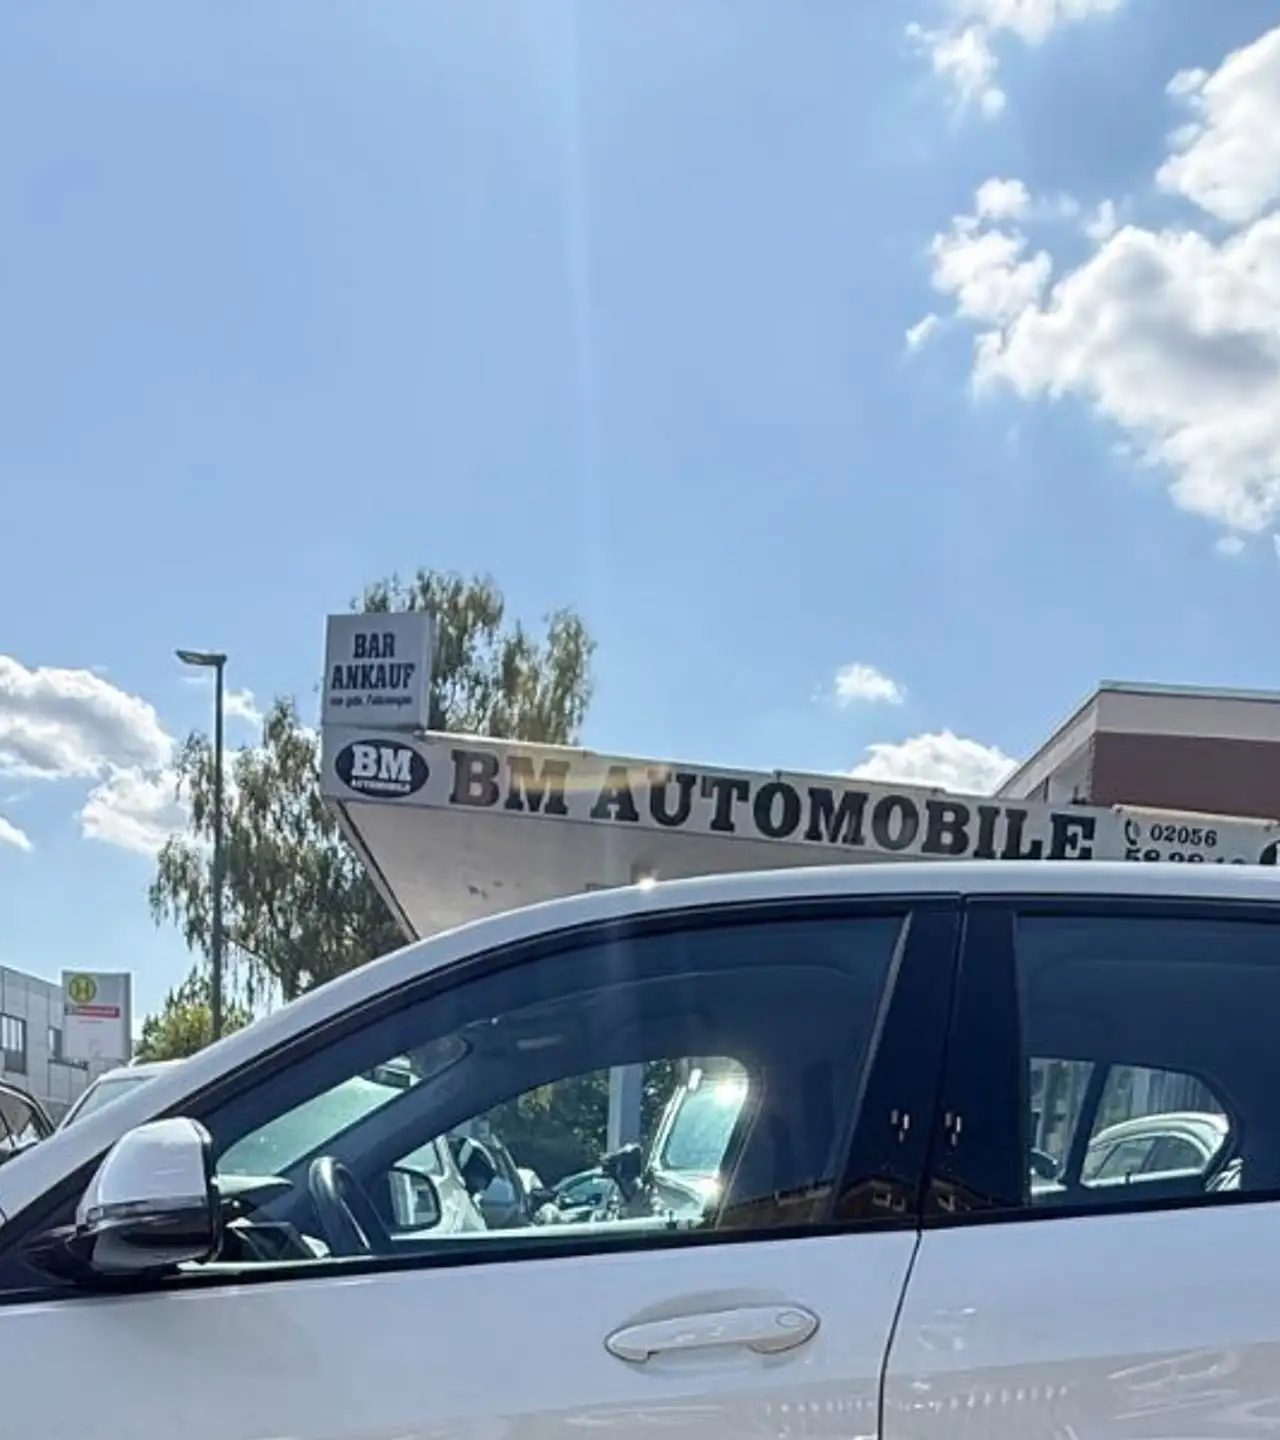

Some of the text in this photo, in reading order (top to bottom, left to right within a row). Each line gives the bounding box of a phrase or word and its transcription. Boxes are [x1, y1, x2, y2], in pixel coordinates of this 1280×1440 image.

[352, 631, 396, 659] BAR
[330, 662, 417, 690] ANKAUF
[351, 743, 413, 781] BM
[448, 748, 1097, 861] BM AUTOMOBILE
[1149, 822, 1219, 848] 02056
